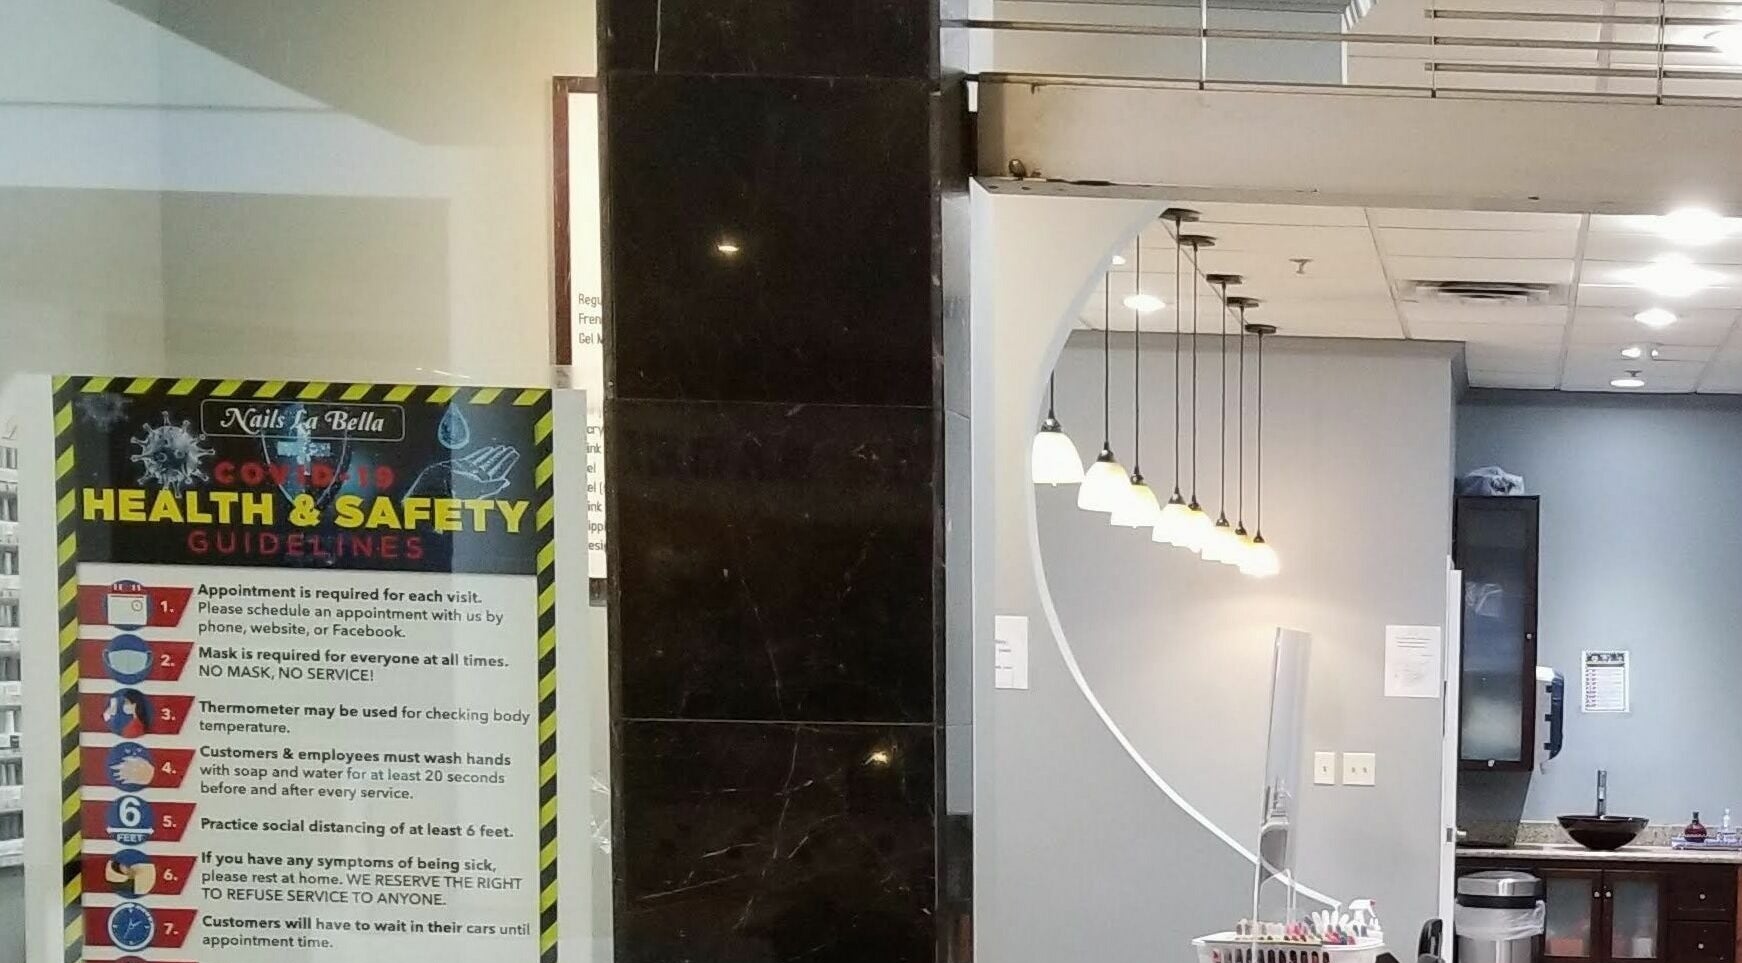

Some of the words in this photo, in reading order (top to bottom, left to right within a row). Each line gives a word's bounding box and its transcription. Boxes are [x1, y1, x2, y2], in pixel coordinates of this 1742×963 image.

[220, 407, 285, 434] Nails
[290, 408, 318, 432] La
[324, 410, 385, 432] Bella
[214, 460, 395, 490] COVID-19
[83, 487, 274, 525] HEALTH
[289, 493, 320, 527] &
[334, 494, 530, 533] SAFETY
[187, 530, 424, 560] GUIDELINES
[197, 583, 295, 601] Appointment
[300, 585, 311, 598] is
[315, 586, 378, 603] required
[382, 587, 405, 601] for
[408, 589, 442, 602] each
[446, 590, 481, 603] visit.
[161, 600, 174, 613] 1.
[198, 600, 243, 614] Please
[246, 602, 310, 616] schedule
[314, 608, 331, 617] an
[336, 605, 427, 623] appointment
[431, 608, 461, 621] with
[466, 612, 481, 621] us
[485, 609, 503, 625] by
[198, 619, 246, 636] phone,
[249, 621, 311, 637] website,
[313, 626, 328, 635] or
[332, 623, 405, 637] Facebook.
[161, 655, 175, 667] 2.
[198, 646, 237, 659] Mask
[241, 650, 253, 659] is
[257, 647, 320, 665] required
[324, 649, 346, 662] for
[350, 653, 419, 667] everyone
[423, 654, 438, 665] at
[441, 652, 458, 665] all
[463, 654, 508, 667] times.
[199, 663, 222, 677] NO
[227, 665, 274, 680] MASK,
[278, 666, 302, 679] NO
[307, 667, 373, 681] SERVICE!
[162, 708, 176, 721] 3.
[198, 700, 300, 715] Thermometer
[304, 706, 335, 719] may
[339, 704, 358, 716] be
[362, 704, 397, 718] used
[401, 705, 421, 718] for
[425, 706, 488, 724] checking
[493, 708, 530, 725] body
[199, 720, 290, 736] temperature.
[200, 745, 278, 759] Customers
[282, 747, 294, 759] &
[298, 747, 379, 765] employees
[384, 752, 420, 763] must
[423, 751, 461, 764] wash
[467, 752, 510, 765] hands
[162, 761, 177, 774] 4.
[199, 763, 230, 776] with
[233, 767, 267, 780] soap
[271, 765, 298, 778] and
[302, 766, 343, 779] water
[346, 766, 366, 779] for
[371, 769, 383, 780] at
[388, 768, 421, 781] least
[424, 769, 442, 781] 20
[446, 770, 504, 783] seconds
[200, 780, 249, 794] before
[250, 782, 277, 795] and
[281, 783, 314, 796] after
[318, 787, 356, 800] every
[360, 789, 413, 799] service.
[119, 797, 141, 828] 6
[163, 815, 177, 828] 5.
[201, 817, 258, 830] Practice
[262, 818, 304, 831] social
[308, 819, 385, 837] distancing
[389, 821, 405, 834] of
[409, 824, 423, 835] at
[427, 822, 462, 836] least
[466, 824, 475, 836] 6
[479, 824, 513, 837] feet.
[116, 833, 144, 844] FEET
[201, 850, 212, 863] If
[215, 855, 243, 867] you
[247, 852, 283, 865] have
[286, 856, 313, 869] any
[317, 856, 393, 871] symptoms
[398, 856, 413, 868] of
[417, 857, 459, 873] being
[464, 858, 496, 872] sick,
[163, 868, 178, 881] 6.
[201, 868, 247, 885] please
[251, 872, 277, 883] rest
[280, 872, 295, 883] at
[298, 870, 343, 885] home.
[346, 873, 371, 885] WE
[374, 874, 441, 888] RESERVE
[444, 876, 474, 889] THE
[477, 876, 522, 889] RIGHT
[201, 887, 222, 899] TO
[227, 888, 283, 901] REFUSE
[286, 889, 348, 903] SERVICE
[351, 890, 373, 903] TO
[376, 892, 446, 905] ANYONE.
[164, 922, 179, 935] 7.
[202, 915, 281, 928] Customers
[284, 916, 311, 929] will
[316, 917, 350, 930] have
[354, 920, 370, 930] to
[373, 919, 406, 932] wait
[410, 920, 423, 932] in
[426, 920, 462, 933] their
[466, 925, 495, 934] cars
[499, 922, 529, 935] until
[202, 933, 294, 949] appointment
[297, 935, 332, 947] time.
